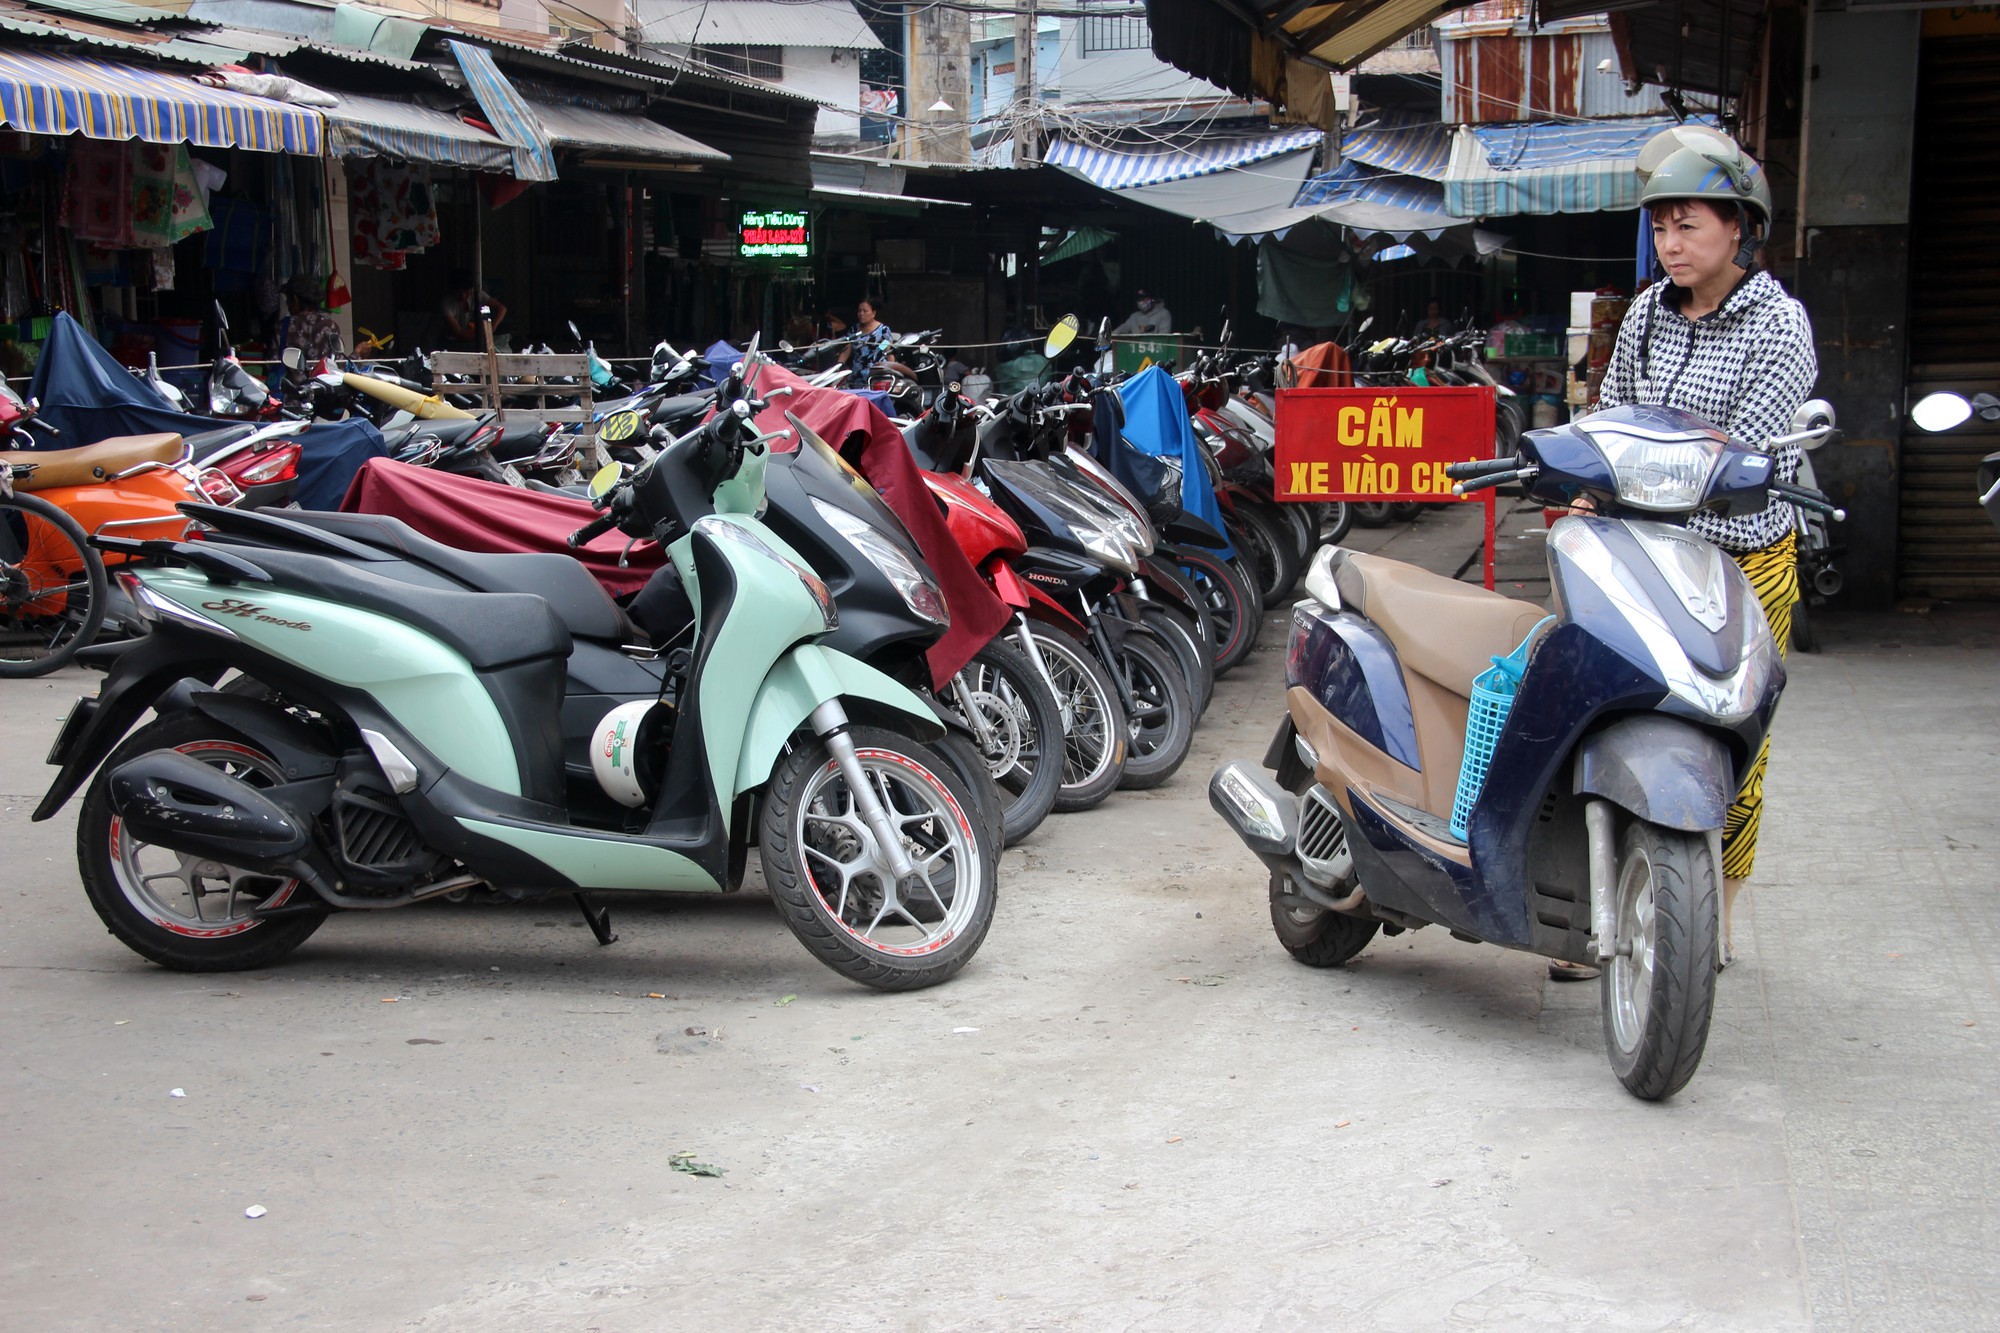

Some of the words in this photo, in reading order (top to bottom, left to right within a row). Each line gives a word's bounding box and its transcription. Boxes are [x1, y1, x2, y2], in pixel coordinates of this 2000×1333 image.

[1337, 396, 1424, 448] CẤM
[1289, 462, 1329, 494] XE
[1342, 453, 1399, 494] VÀO
[1411, 456, 1474, 500] CH
[1028, 573, 1068, 586] HONDA
[201, 599, 268, 617] SH
[254, 615, 312, 631] mode
